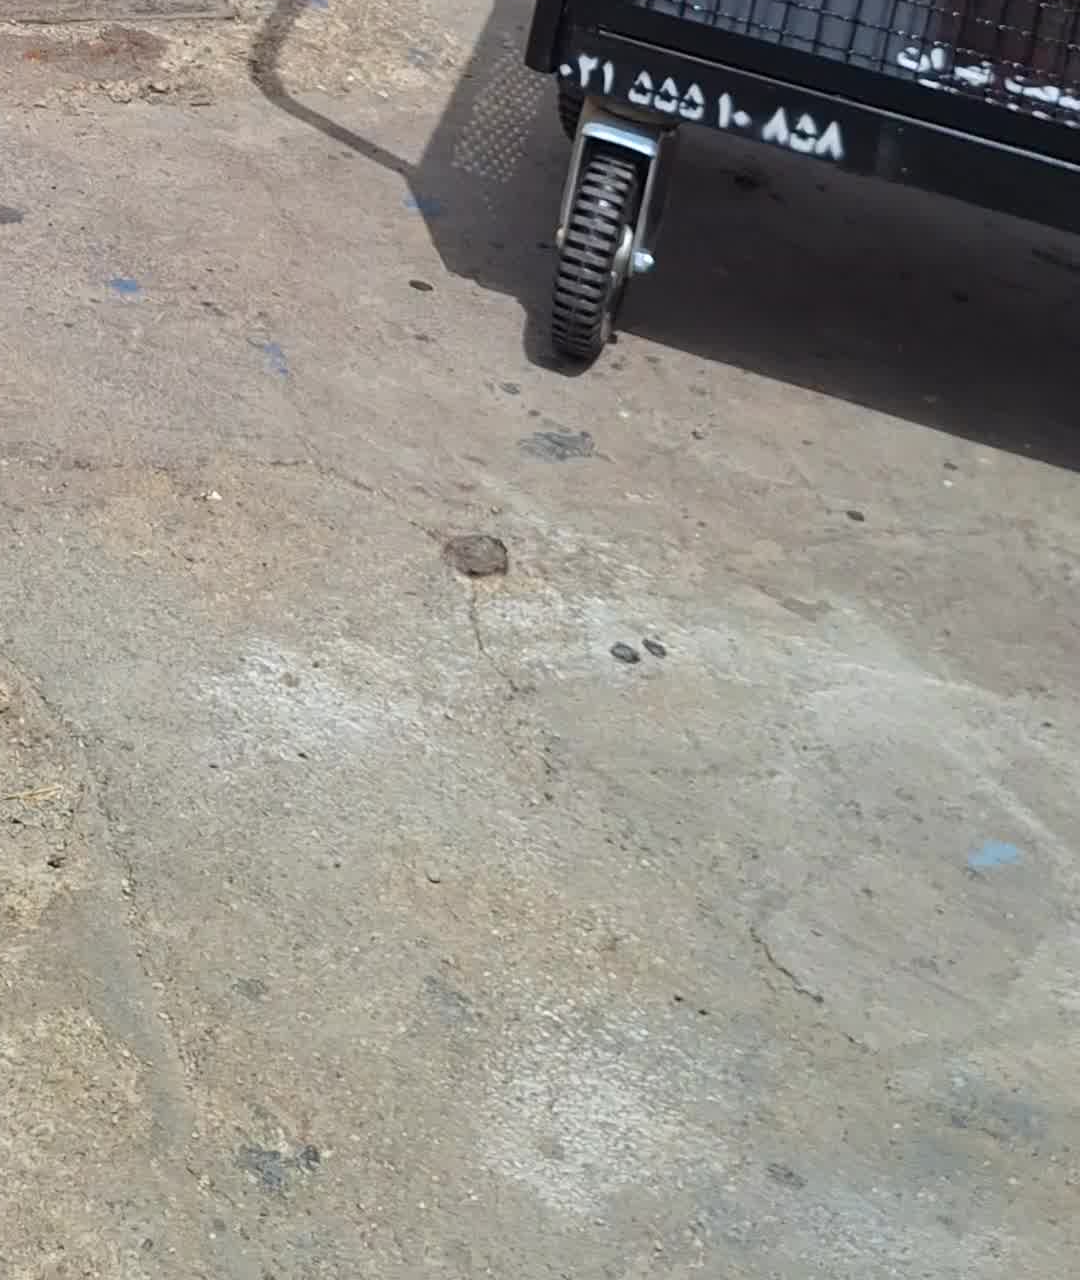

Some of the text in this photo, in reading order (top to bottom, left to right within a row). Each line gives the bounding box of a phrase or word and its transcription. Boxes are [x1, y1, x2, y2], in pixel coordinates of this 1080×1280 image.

[557, 52, 846, 161] ۰۲۱ ۵۵۵ ۱۰ ۸۵۸
